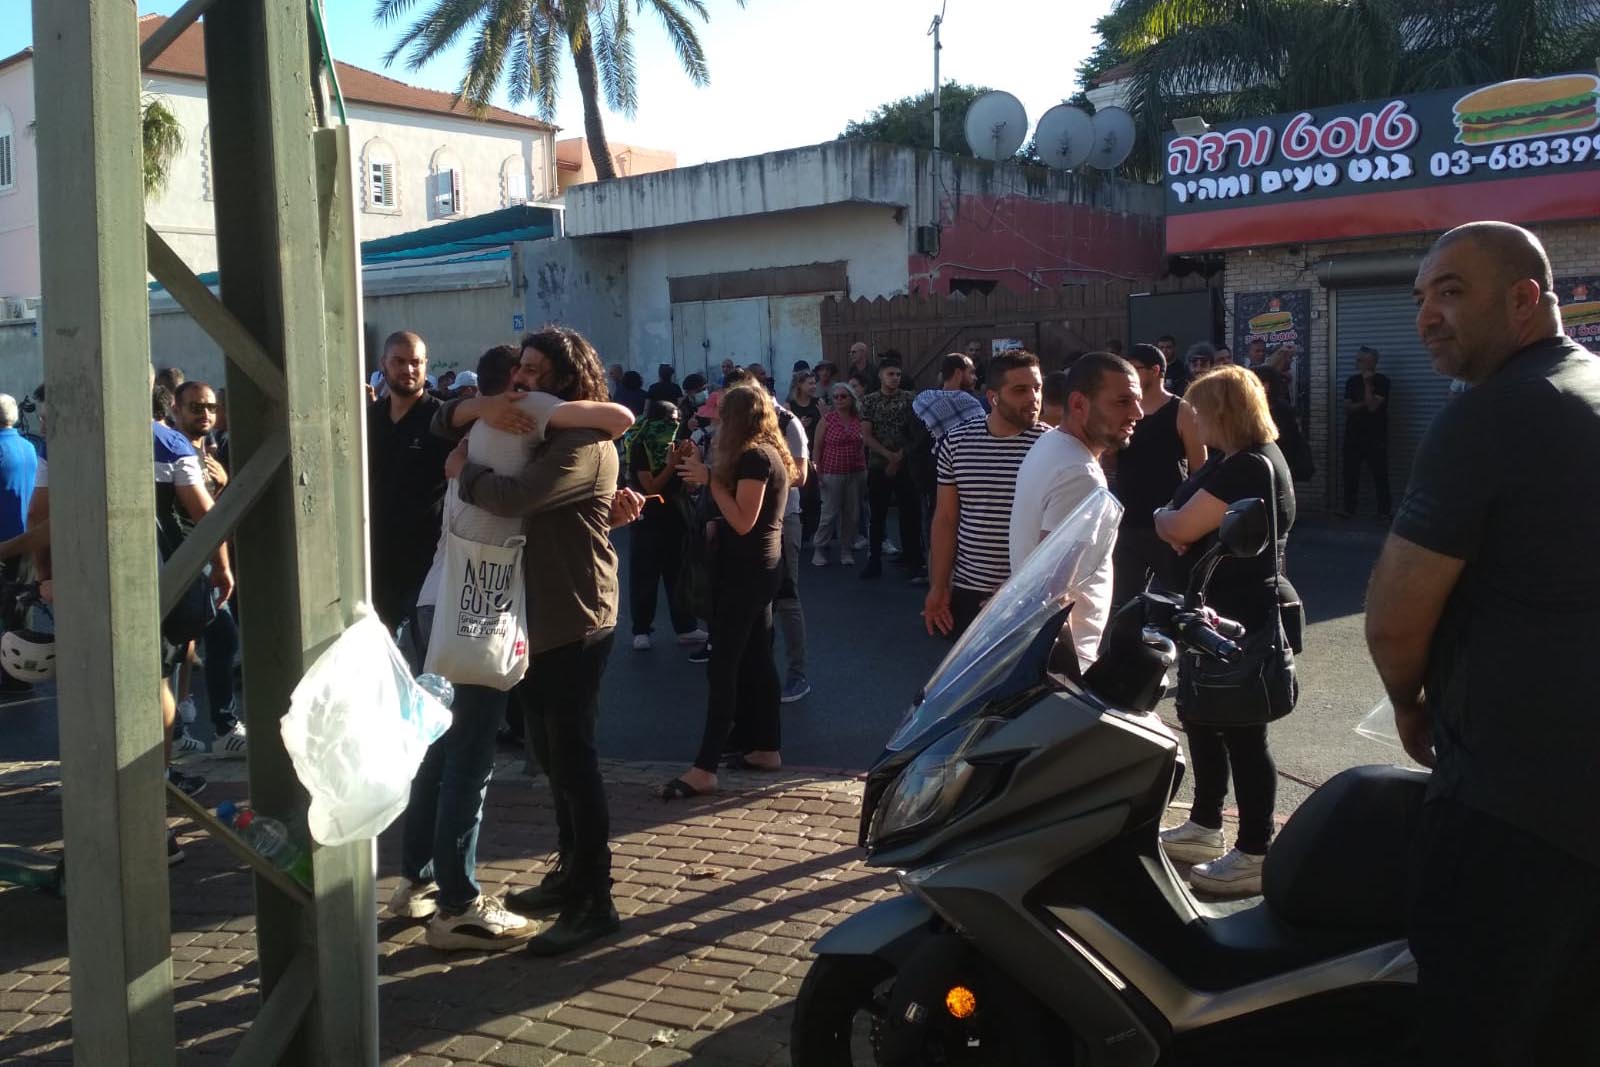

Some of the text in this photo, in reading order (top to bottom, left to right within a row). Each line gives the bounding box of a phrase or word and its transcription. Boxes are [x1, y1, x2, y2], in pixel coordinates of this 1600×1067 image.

[1168, 100, 1418, 175] טוסט ורדה
[1171, 153, 1413, 203] בגט טעים ומהיר
[460, 584, 494, 616] GUT
